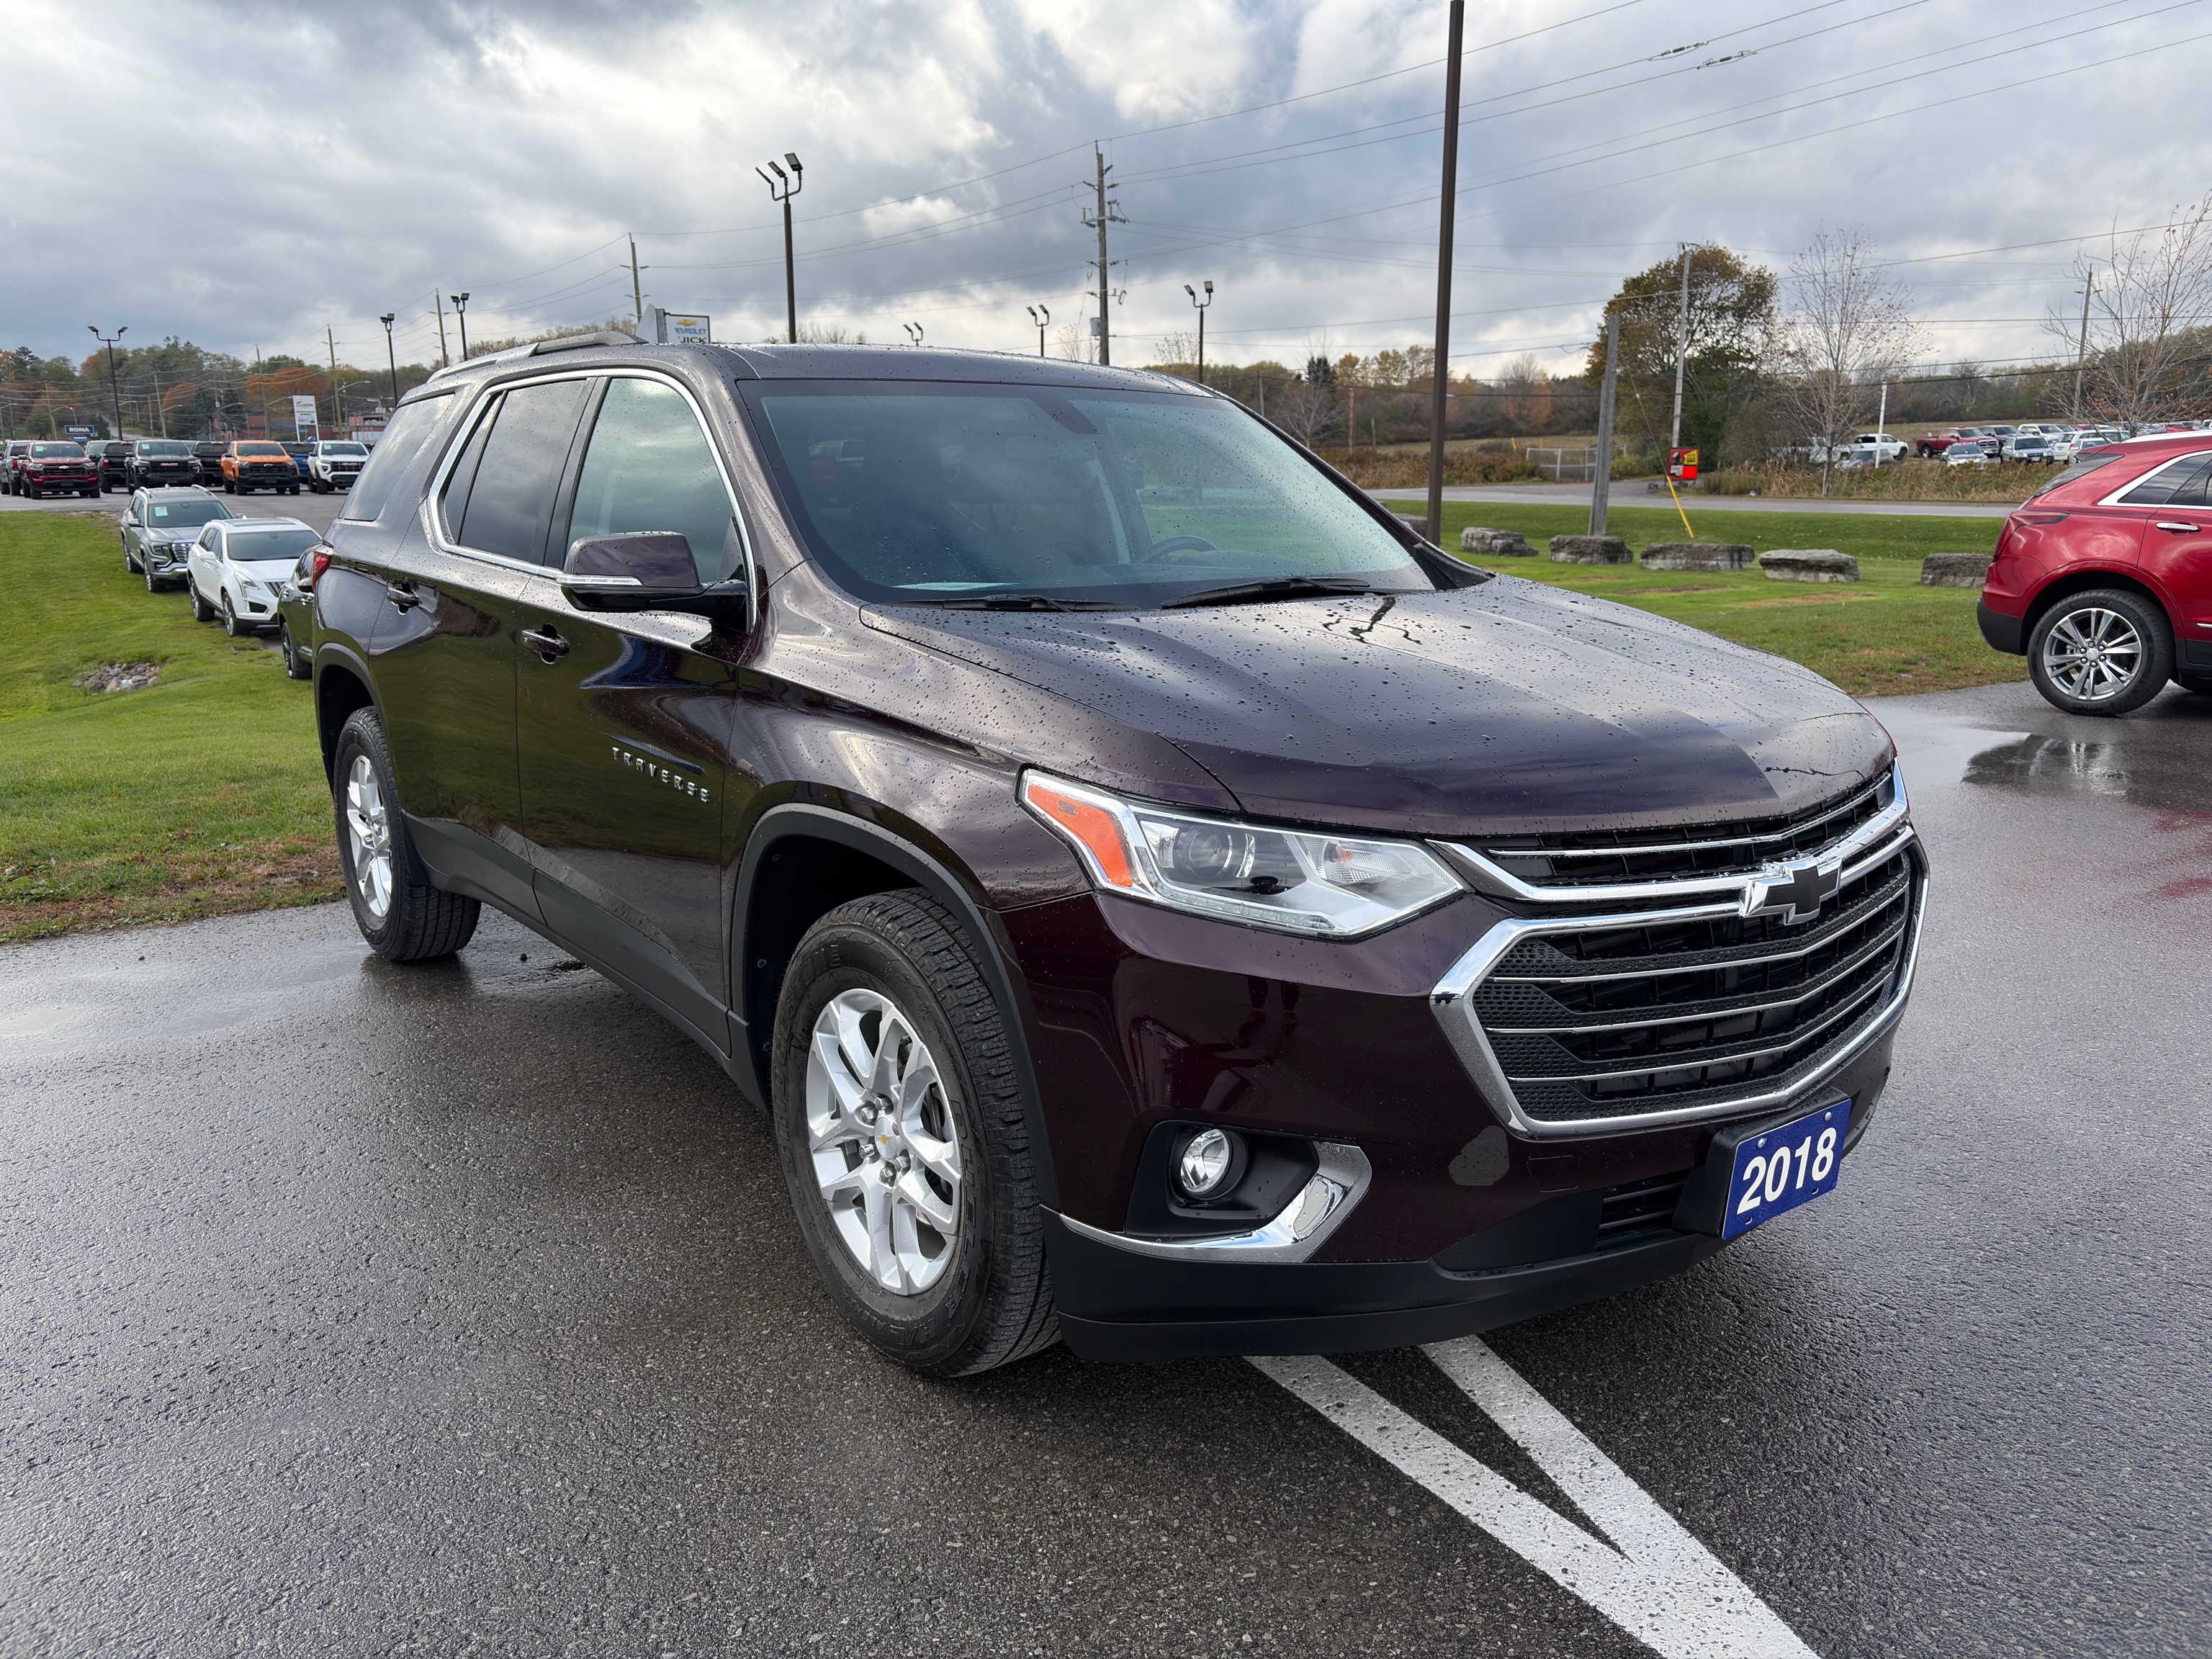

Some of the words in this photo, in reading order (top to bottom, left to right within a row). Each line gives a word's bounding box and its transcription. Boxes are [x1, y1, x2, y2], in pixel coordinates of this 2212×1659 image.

[612, 747, 710, 803] TRAVERSE
[945, 1099, 977, 1318] DUELER
[1737, 1128, 1837, 1215] 2018
